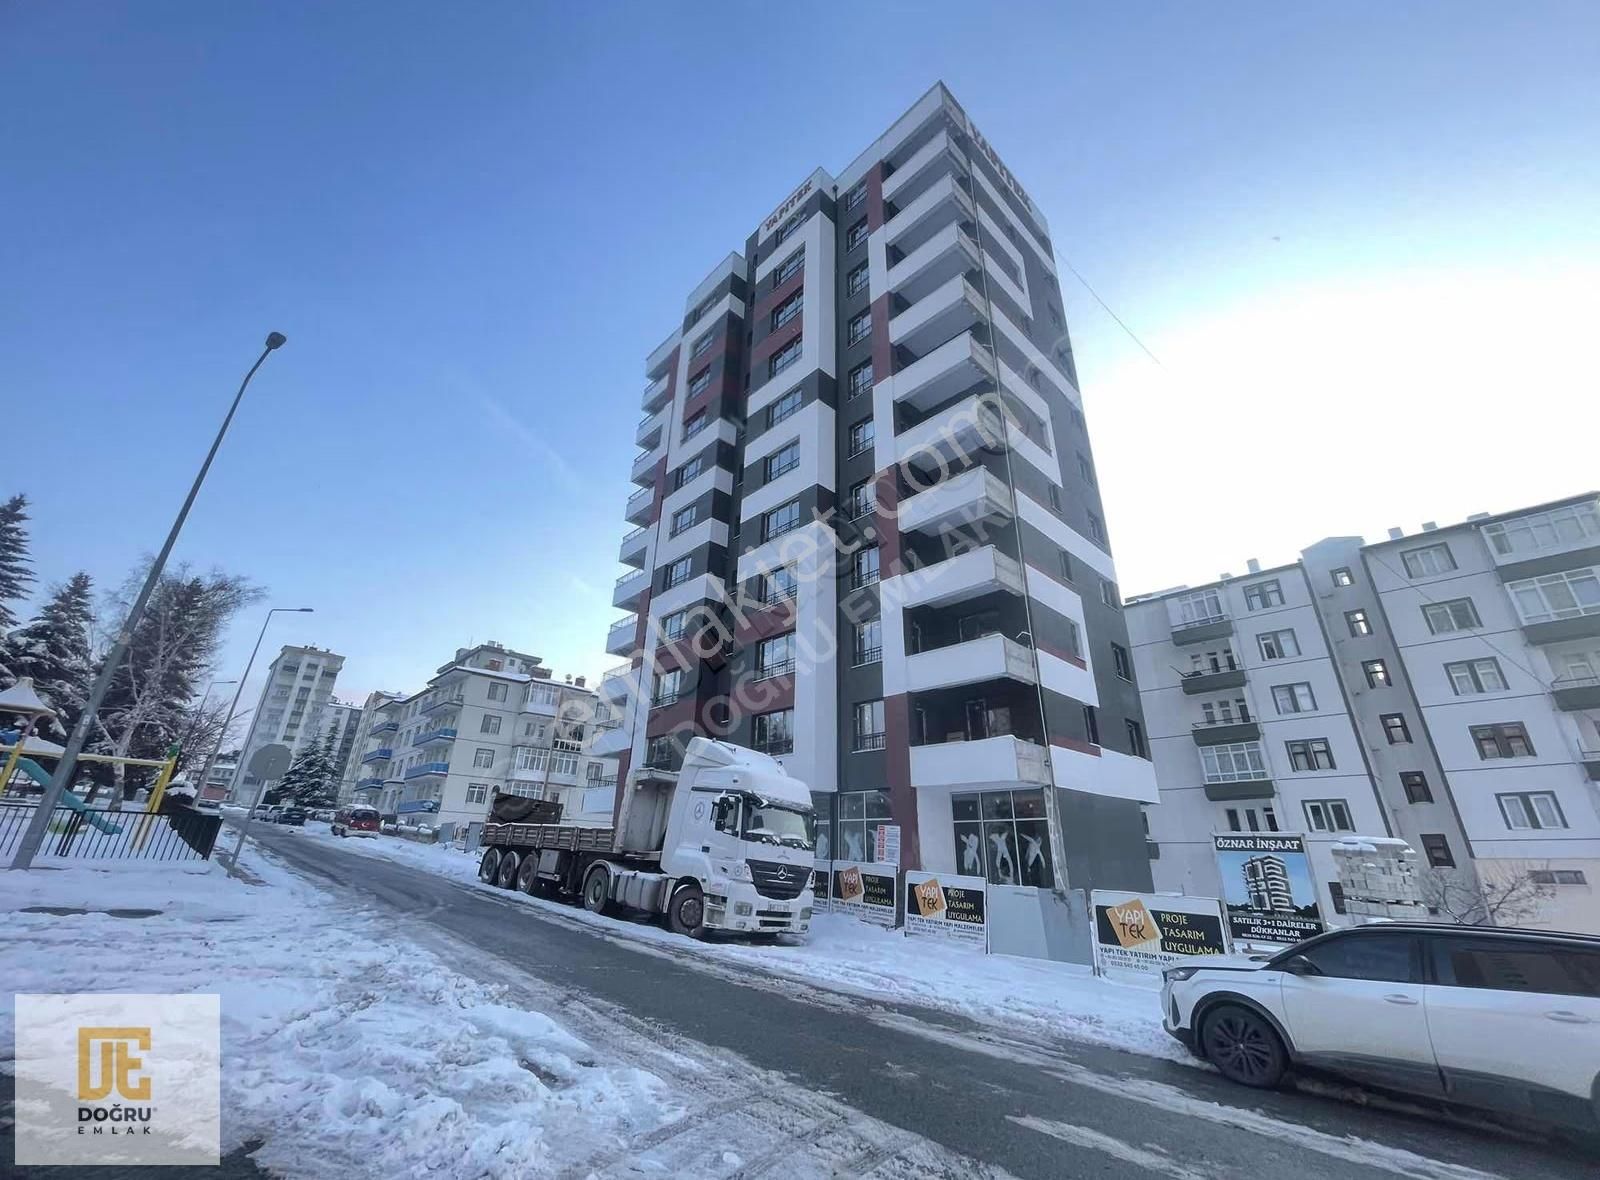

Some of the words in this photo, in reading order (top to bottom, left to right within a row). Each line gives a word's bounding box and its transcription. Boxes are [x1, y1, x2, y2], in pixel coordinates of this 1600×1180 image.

[1216, 837, 1255, 849] ÖZNAR
[1256, 837, 1300, 851] İNŞAAT
[919, 886, 938, 898] YAPI
[948, 888, 966, 899] PROJE
[920, 897, 938, 910] TEK
[948, 900, 975, 910] TASARIM
[947, 911, 983, 923] UYGULAMA
[1115, 907, 1145, 924] YAPI
[1160, 913, 1188, 926] PROJE
[1232, 916, 1262, 925] SATILIK
[1276, 919, 1317, 930] DAİRELER
[1119, 922, 1146, 940] TEK
[1162, 927, 1205, 940] TASARIM
[1251, 925, 1301, 937] DÜKKANLAR
[1100, 947, 1114, 955] YAPI
[1115, 948, 1129, 957] TEK
[1130, 951, 1157, 960] YATIRIM
[1158, 954, 1175, 962] YAPI
[1164, 942, 1220, 955] UYGULAMA
